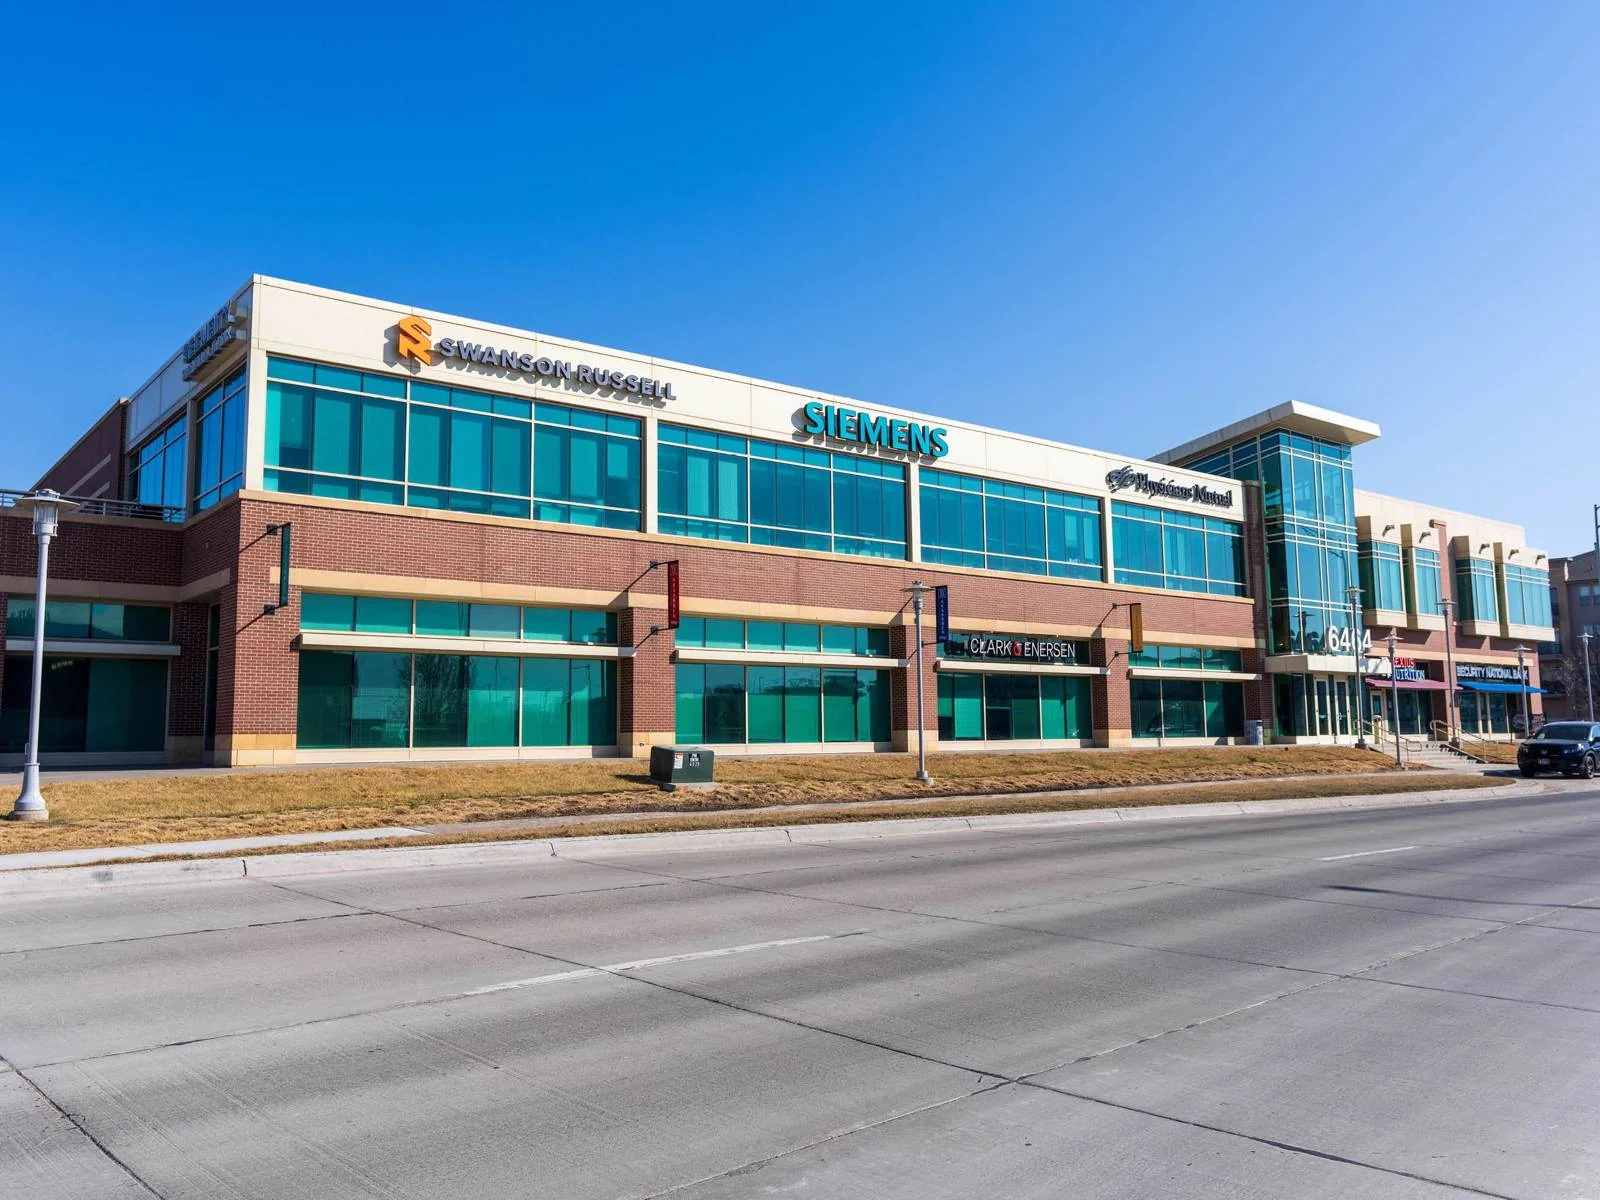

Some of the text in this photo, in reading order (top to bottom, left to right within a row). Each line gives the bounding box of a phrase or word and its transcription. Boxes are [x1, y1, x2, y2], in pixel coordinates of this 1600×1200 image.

[440, 338, 677, 400] SWANSON RUSSELL
[804, 402, 949, 458] SIEMENS
[970, 638, 1076, 658] CLARK & ENERSEN
[1394, 668, 1425, 681] UTRITION
[1513, 669, 1529, 680] BAK
